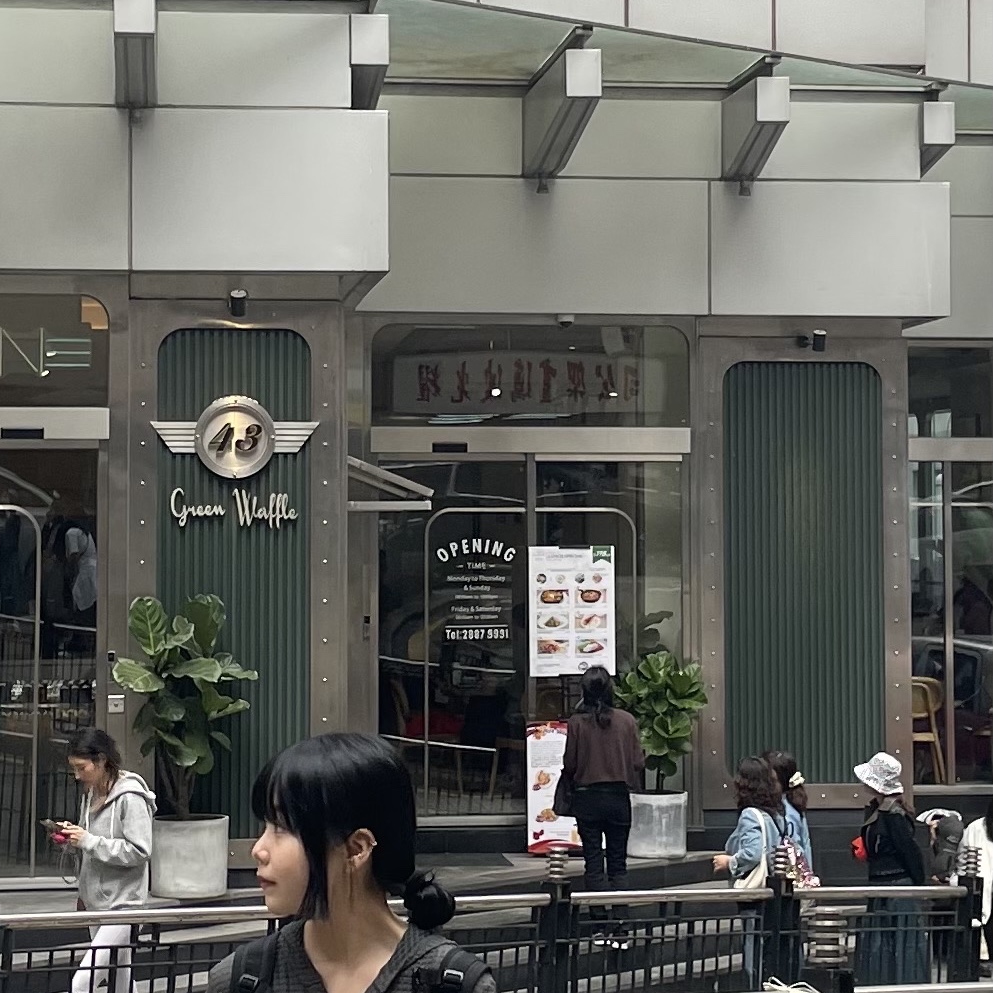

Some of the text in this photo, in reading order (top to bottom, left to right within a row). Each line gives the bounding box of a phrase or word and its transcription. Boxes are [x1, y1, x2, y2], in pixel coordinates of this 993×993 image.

[209, 422, 263, 452] 43
[170, 487, 299, 529] Green Waffle
[436, 538, 517, 562] OPENING
